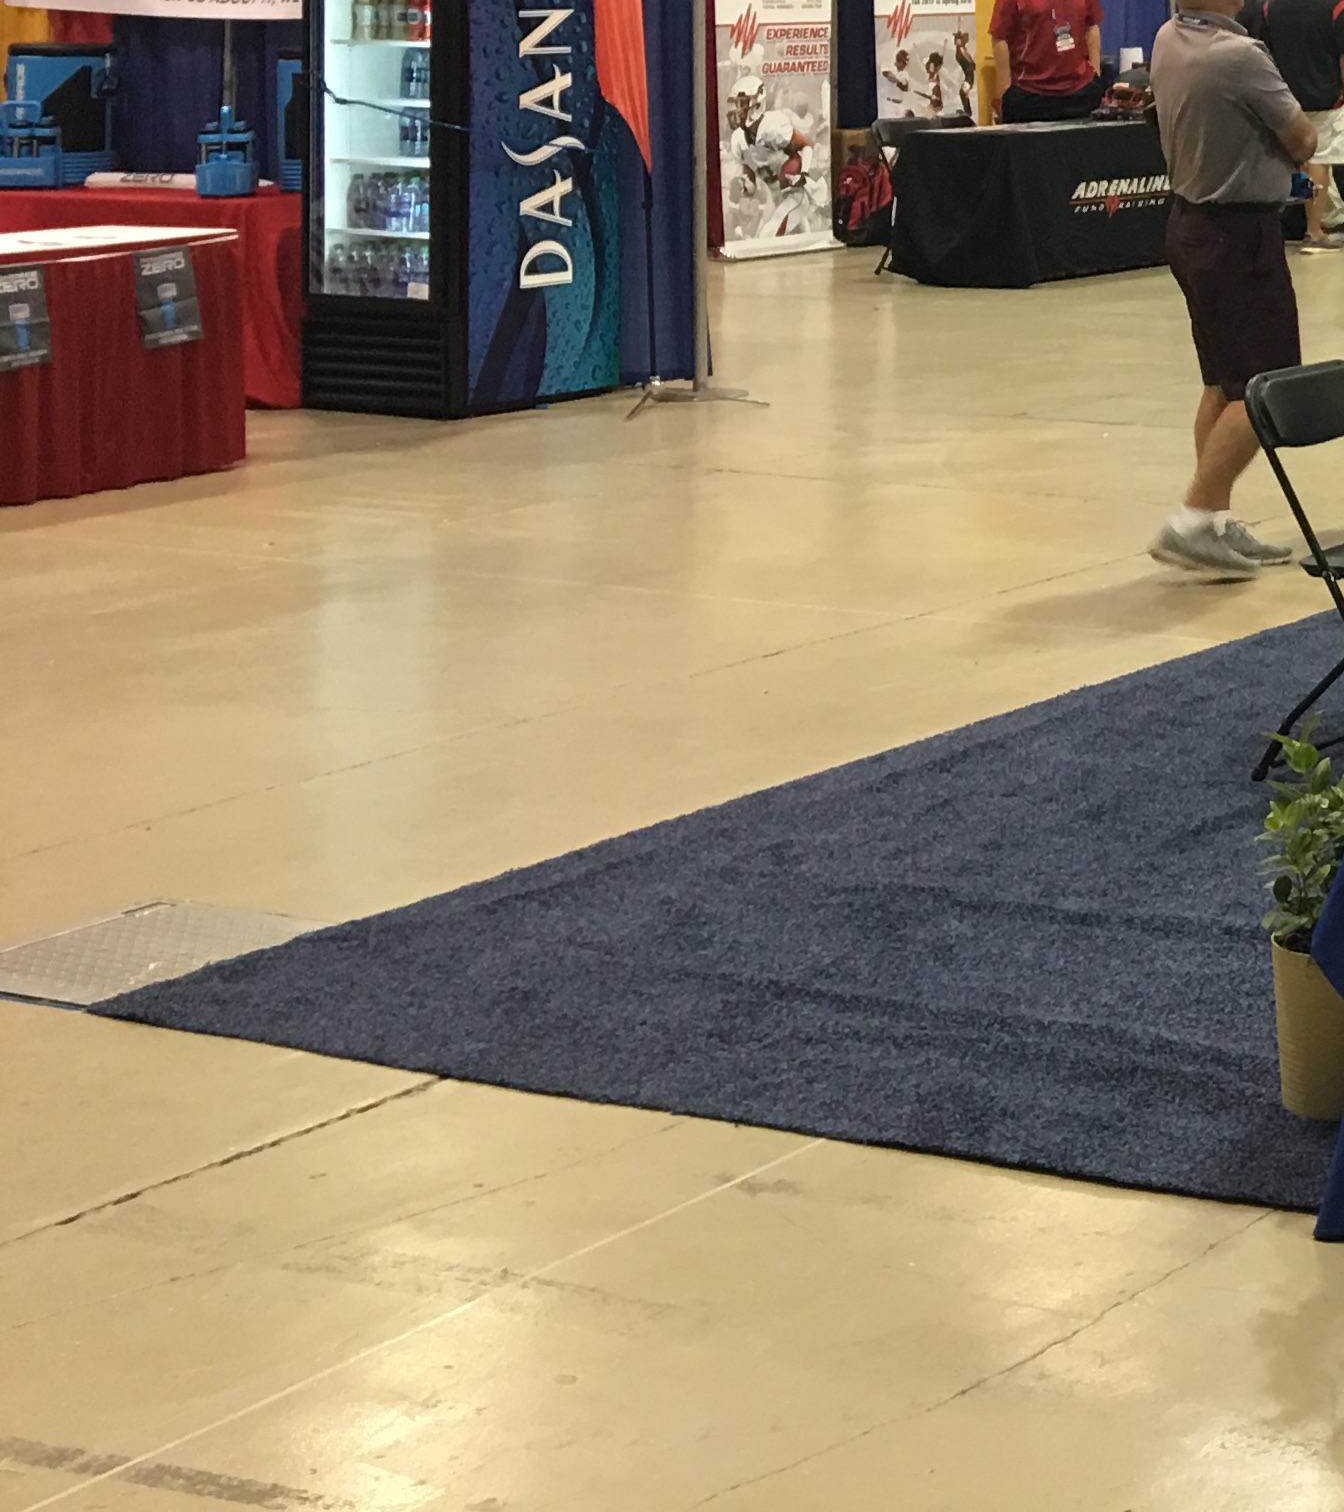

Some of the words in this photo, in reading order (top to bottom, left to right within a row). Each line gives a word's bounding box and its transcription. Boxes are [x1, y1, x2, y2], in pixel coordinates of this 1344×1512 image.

[766, 27, 829, 40] EXPERIENCE
[786, 44, 829, 57] RESULTS
[762, 61, 829, 75] GUARANTEED
[140, 258, 186, 276] ZERO
[0, 277, 40, 294] ERO
